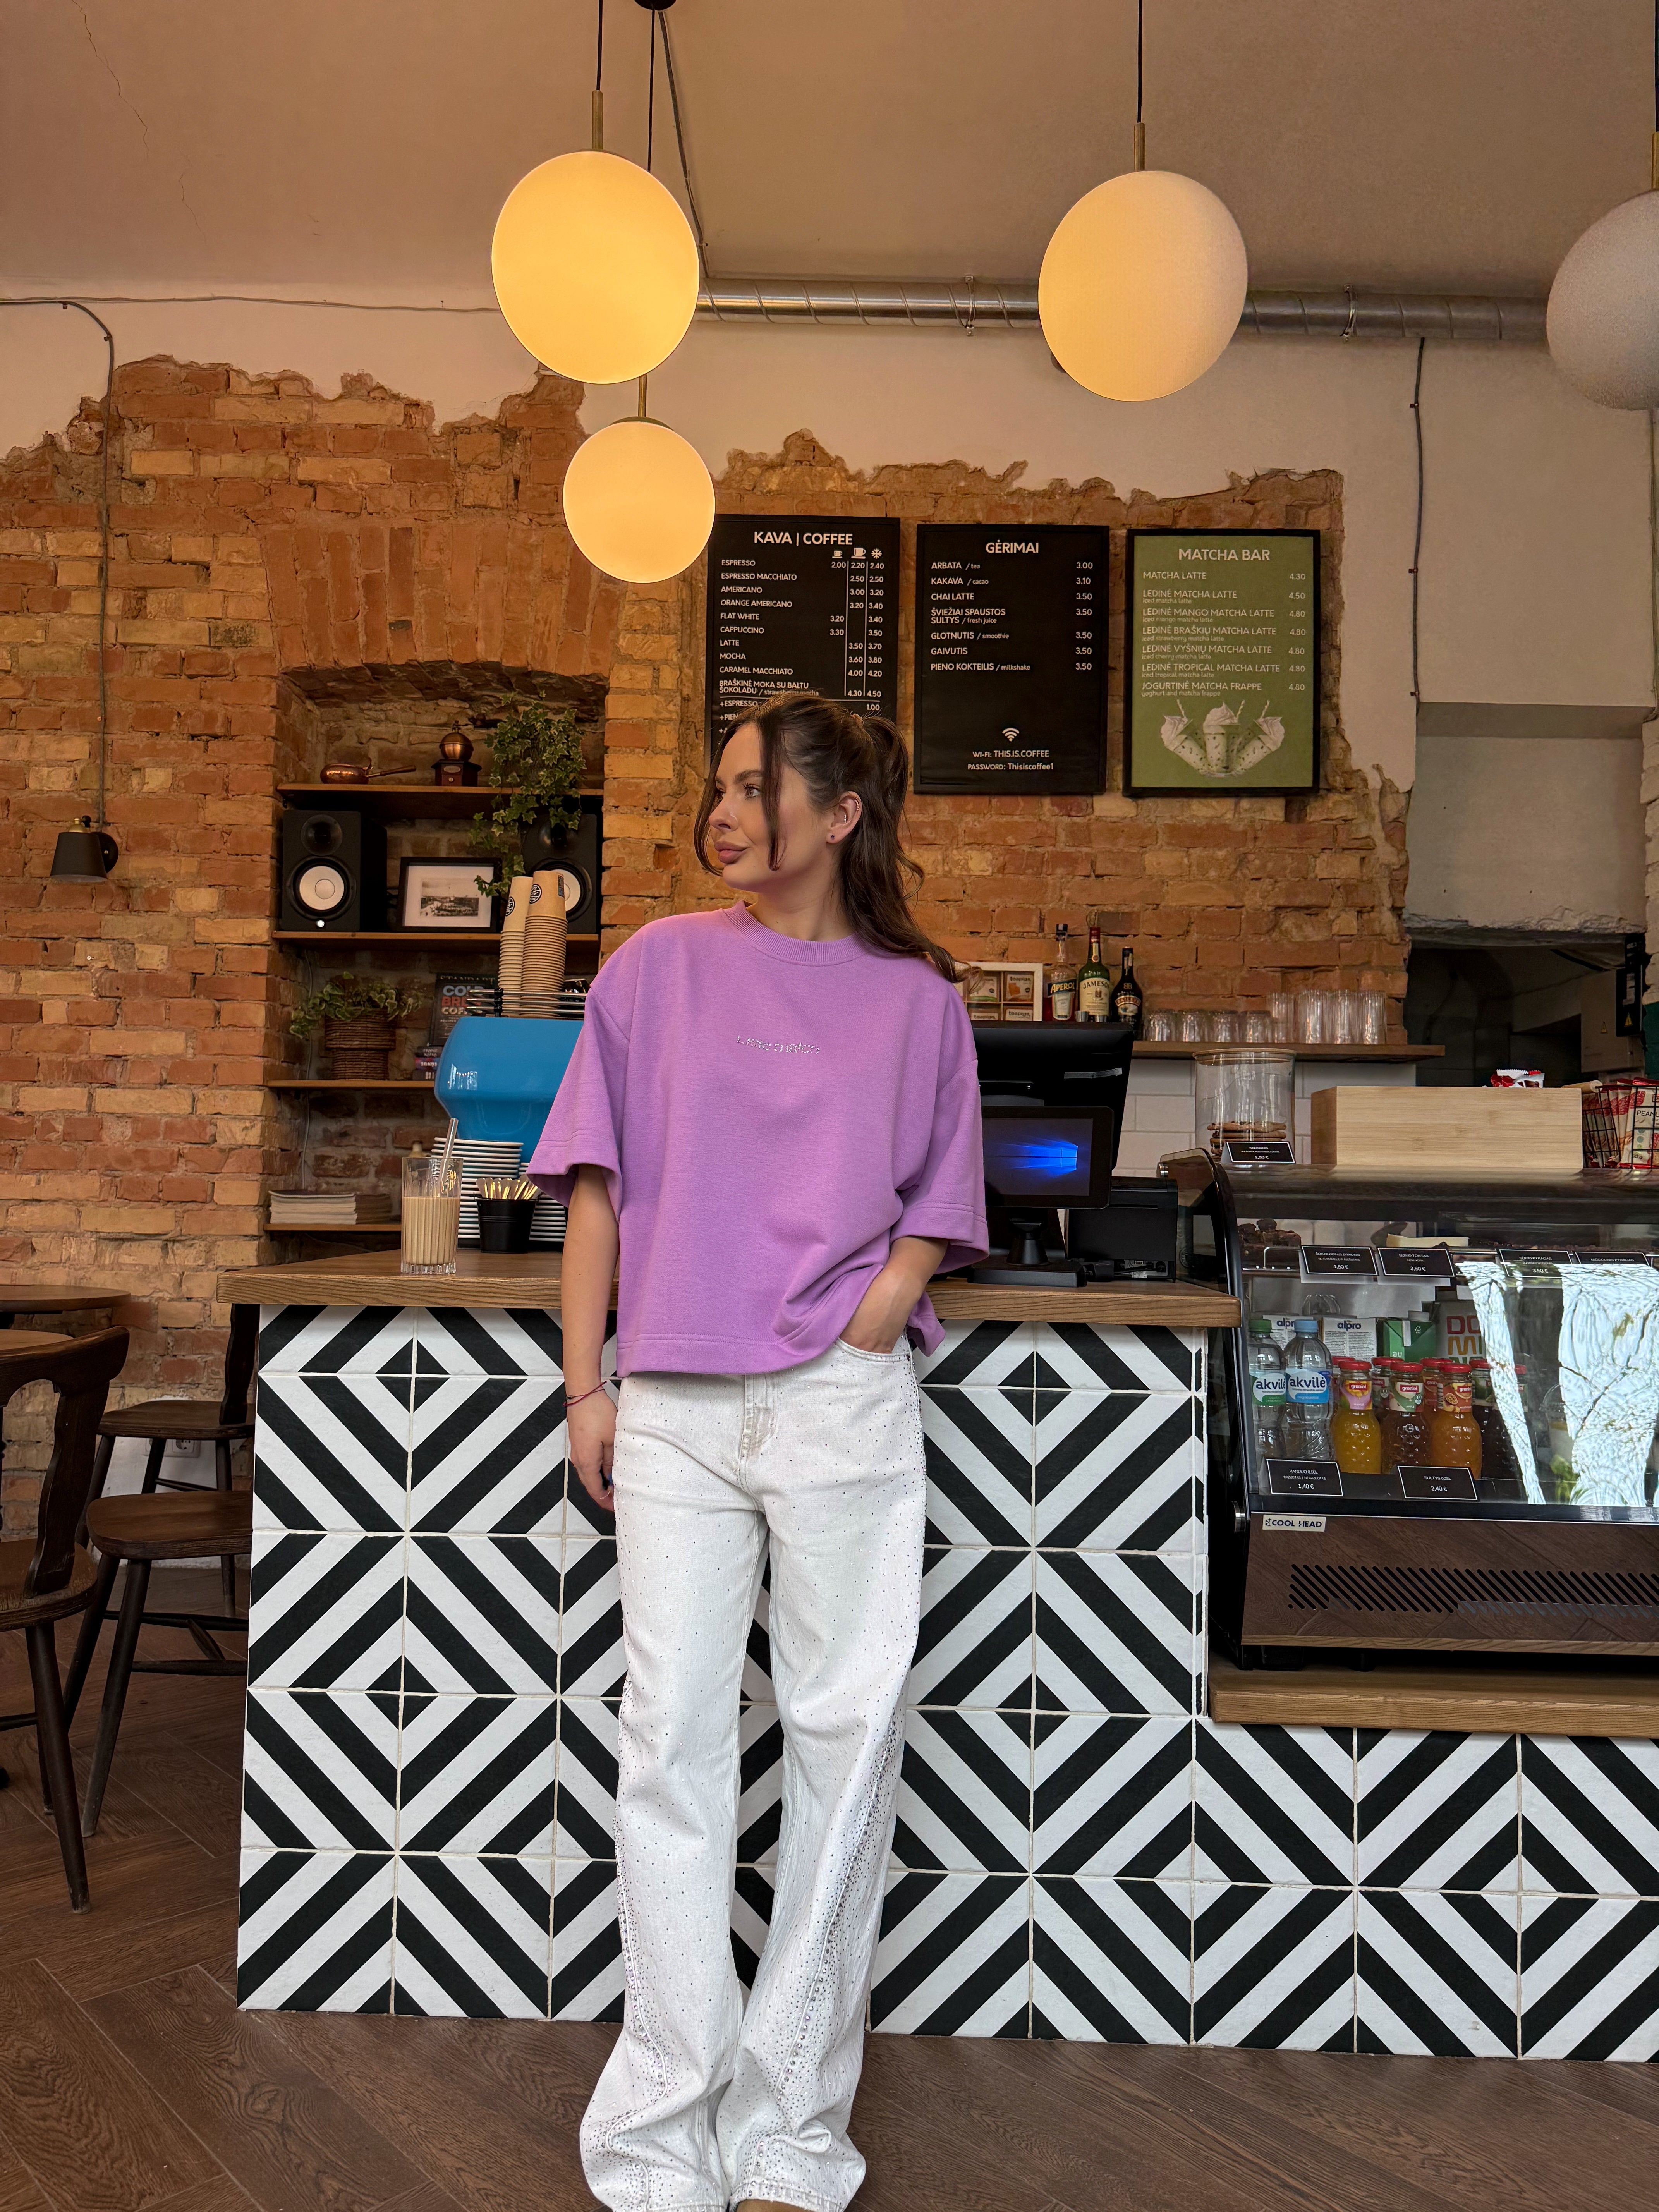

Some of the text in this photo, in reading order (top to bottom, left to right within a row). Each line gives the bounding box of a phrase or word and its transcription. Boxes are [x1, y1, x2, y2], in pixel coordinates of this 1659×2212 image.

[754, 532, 853, 545] KAVA COFFEE
[986, 539, 1039, 553] GĖRIMAI
[1179, 548, 1270, 560] MATCHA BAR
[1143, 588, 1171, 598] LEDINĖ
[931, 607, 963, 616] ŠVIEŽIAI
[1143, 607, 1171, 616] LEDINĖ
[1249, 609, 1274, 617] LATTE
[931, 616, 960, 624] SULTYS
[720, 626, 764, 634] CAPPUCCINO
[1143, 626, 1171, 635] LEDINĖ
[931, 632, 974, 640] GLOTNUTIS
[931, 647, 968, 655] GAIVUTIS
[1142, 643, 1171, 653] LEDINĖ
[1209, 645, 1245, 653] MATCHA
[1142, 662, 1171, 671] LEDINĖ
[1216, 664, 1253, 672] MATCHA
[719, 678, 752, 687] BRAŠKINĖ
[1192, 682, 1228, 690] MATCHA
[1230, 682, 1262, 690] FRAPPE
[443, 985, 484, 996] CO
[1051, 982, 1075, 993] APEROL
[441, 1007, 483, 1015] COF
[1276, 1318, 1295, 1329] alpr
[1337, 1320, 1361, 1331] alpro
[1256, 1378, 1286, 1389] akvilė
[1290, 1377, 1326, 1388] akvilė
